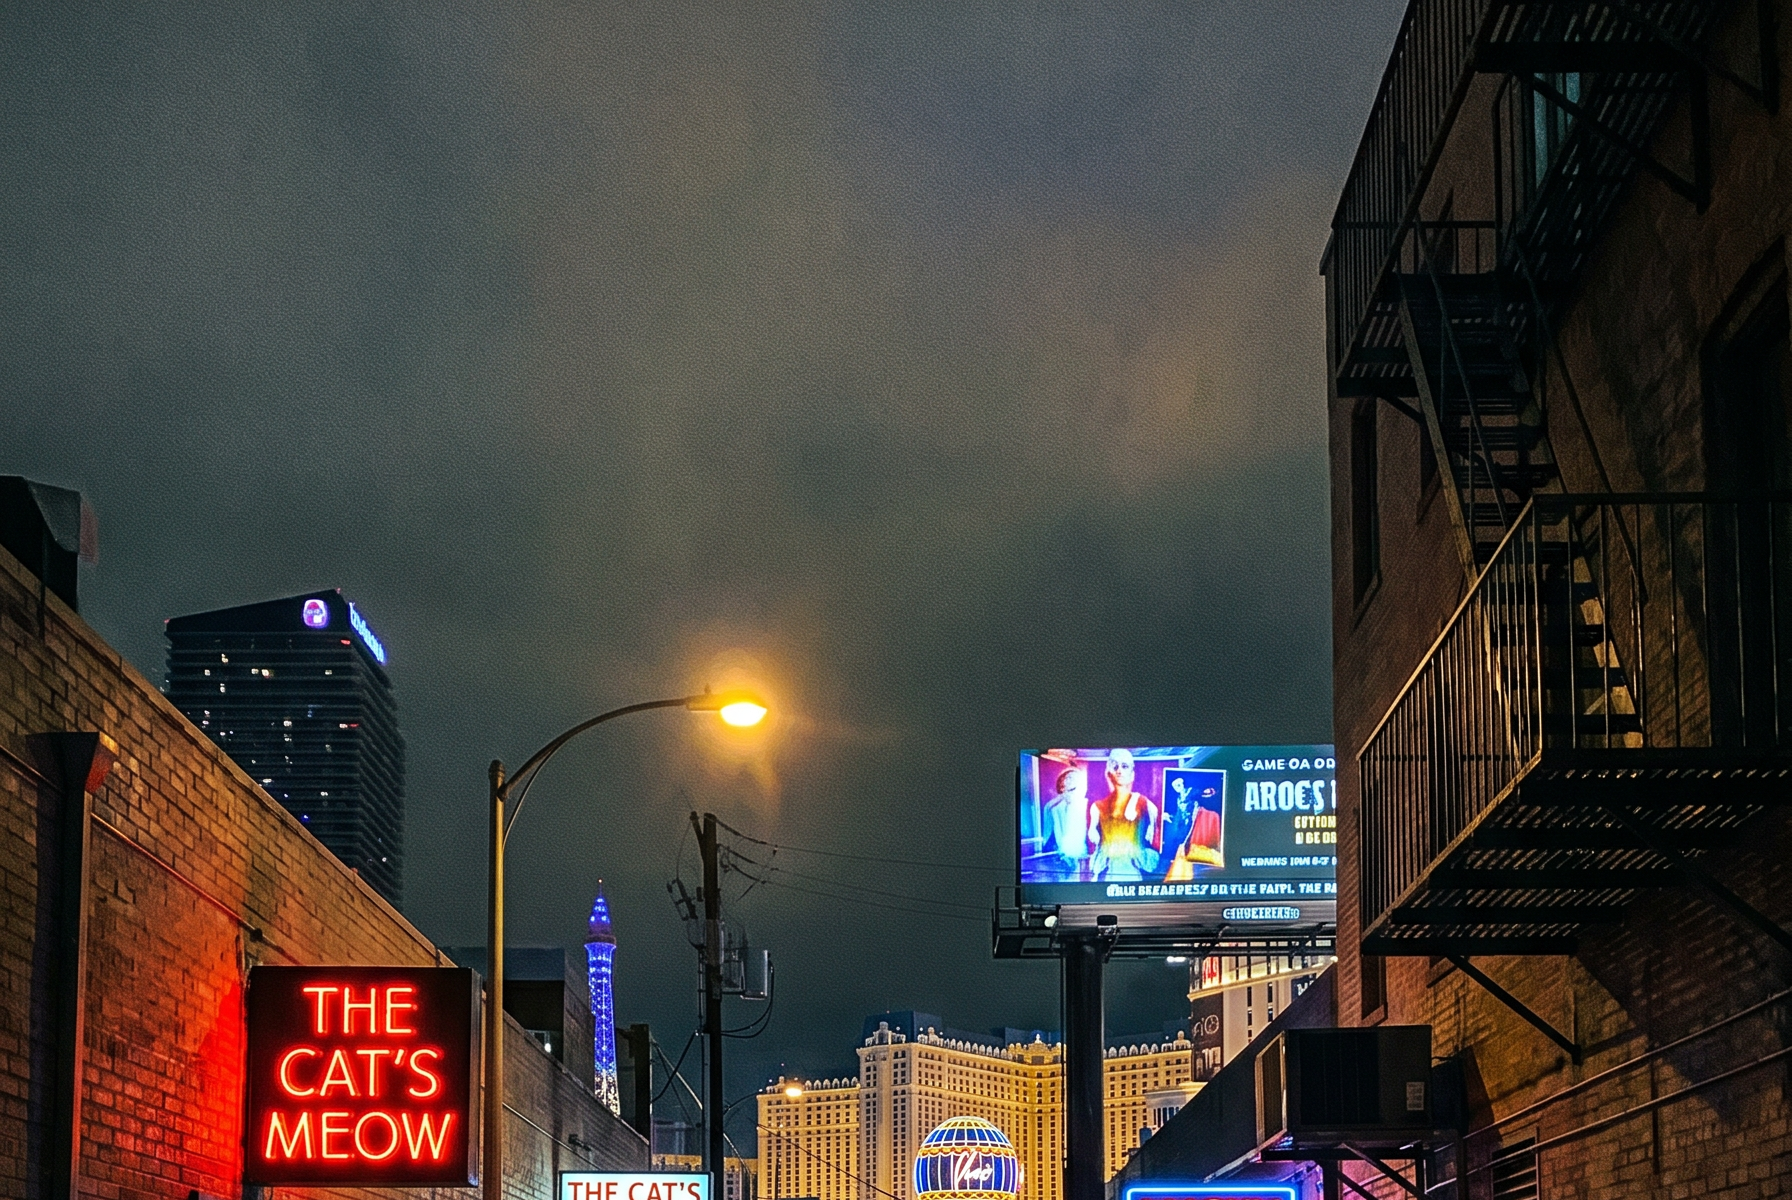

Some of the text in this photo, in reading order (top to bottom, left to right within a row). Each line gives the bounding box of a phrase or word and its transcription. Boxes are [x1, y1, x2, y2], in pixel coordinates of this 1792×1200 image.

[303, 987, 414, 1035] THE
[280, 1047, 439, 1098] CAT'S
[264, 1110, 451, 1161] MEOW
